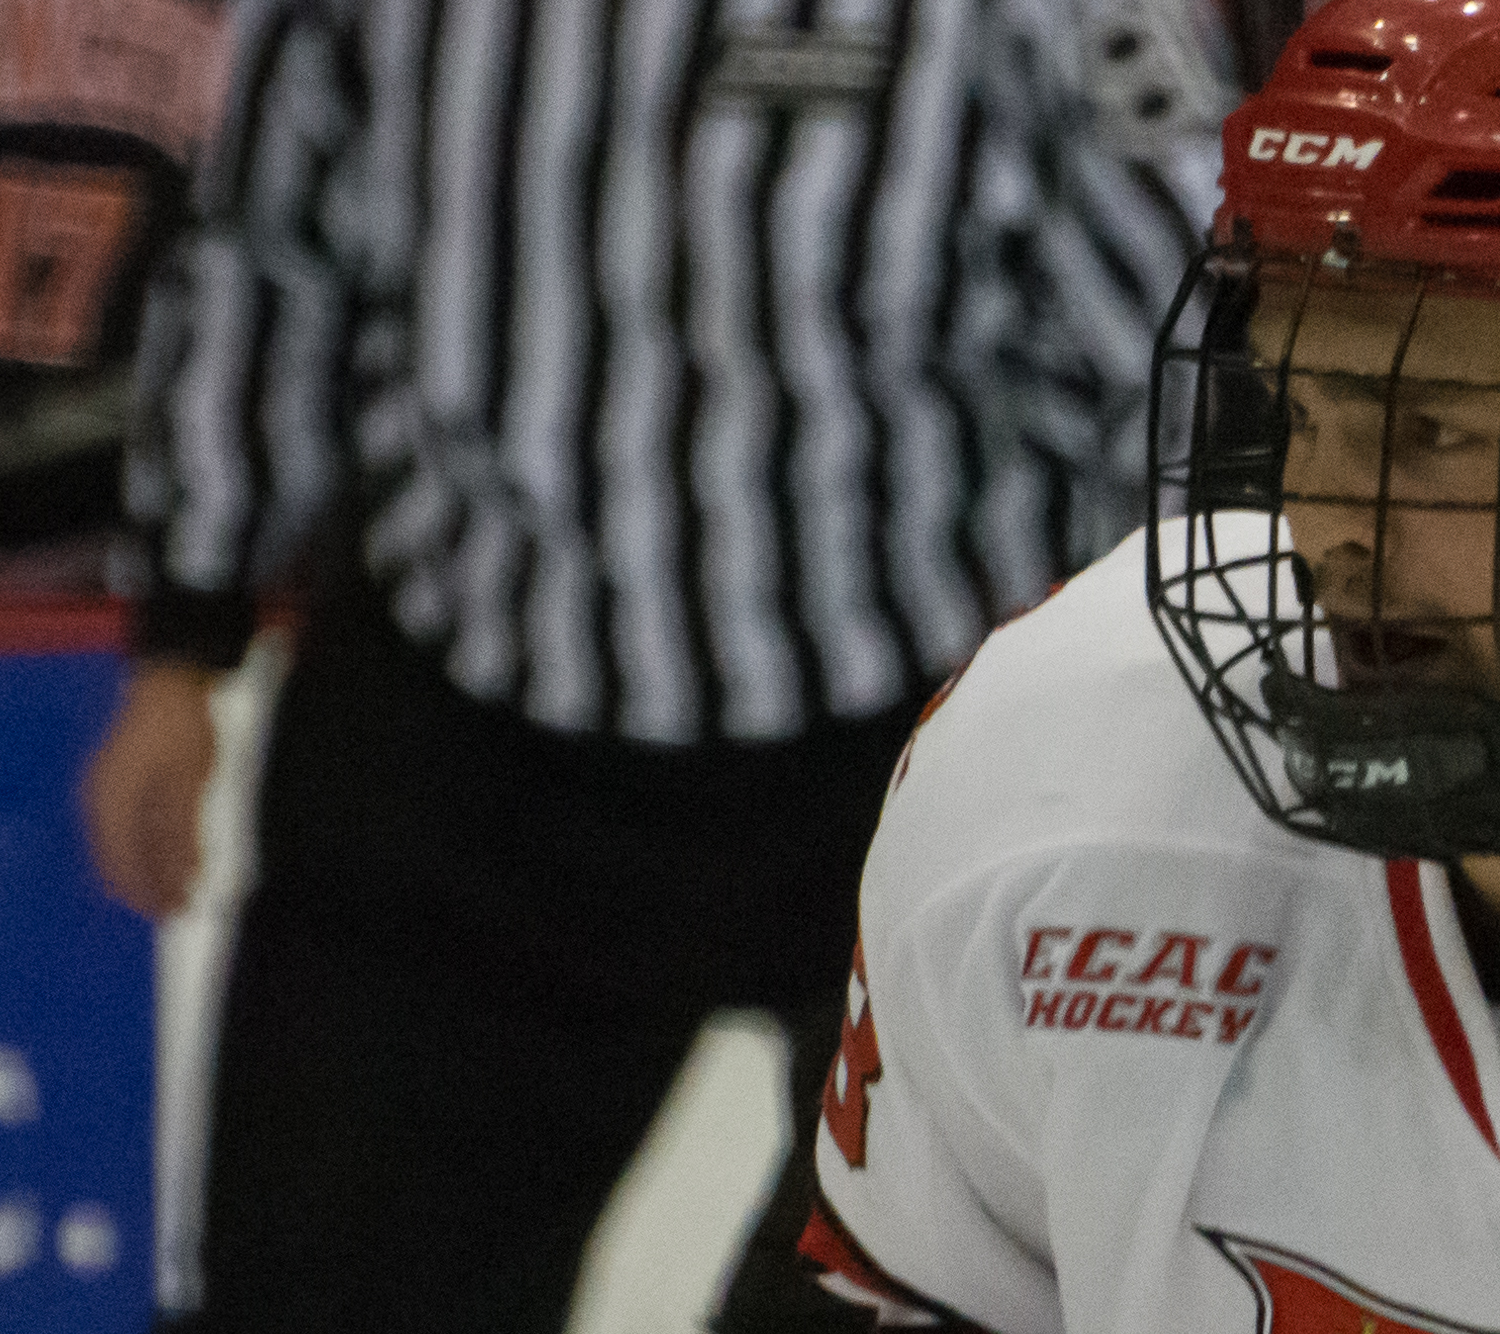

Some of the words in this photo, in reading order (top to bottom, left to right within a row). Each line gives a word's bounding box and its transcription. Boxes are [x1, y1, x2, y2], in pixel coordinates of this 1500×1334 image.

[1246, 125, 1385, 171] CCM
[1021, 926, 1277, 997] ECAC
[1025, 989, 1258, 1045] HOCKEY
